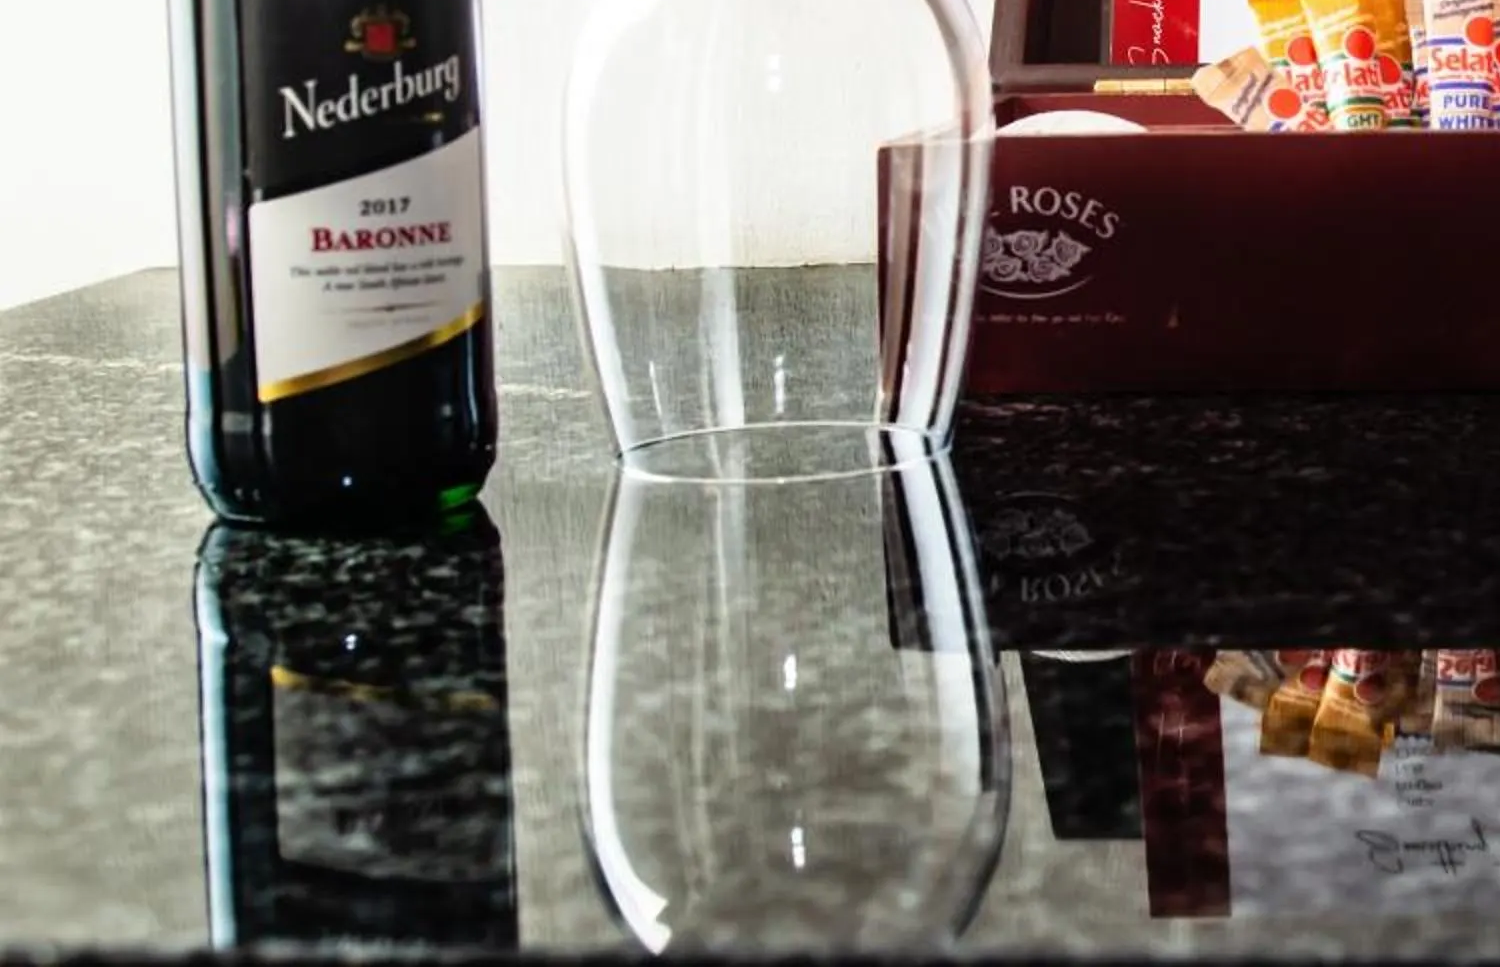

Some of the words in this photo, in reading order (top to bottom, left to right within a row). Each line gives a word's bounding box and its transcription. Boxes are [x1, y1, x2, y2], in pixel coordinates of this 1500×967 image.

[279, 55, 460, 139] Nederburg
[359, 196, 411, 217] 2017
[1009, 185, 1120, 240] ROSES
[311, 221, 452, 252] BARONNE
